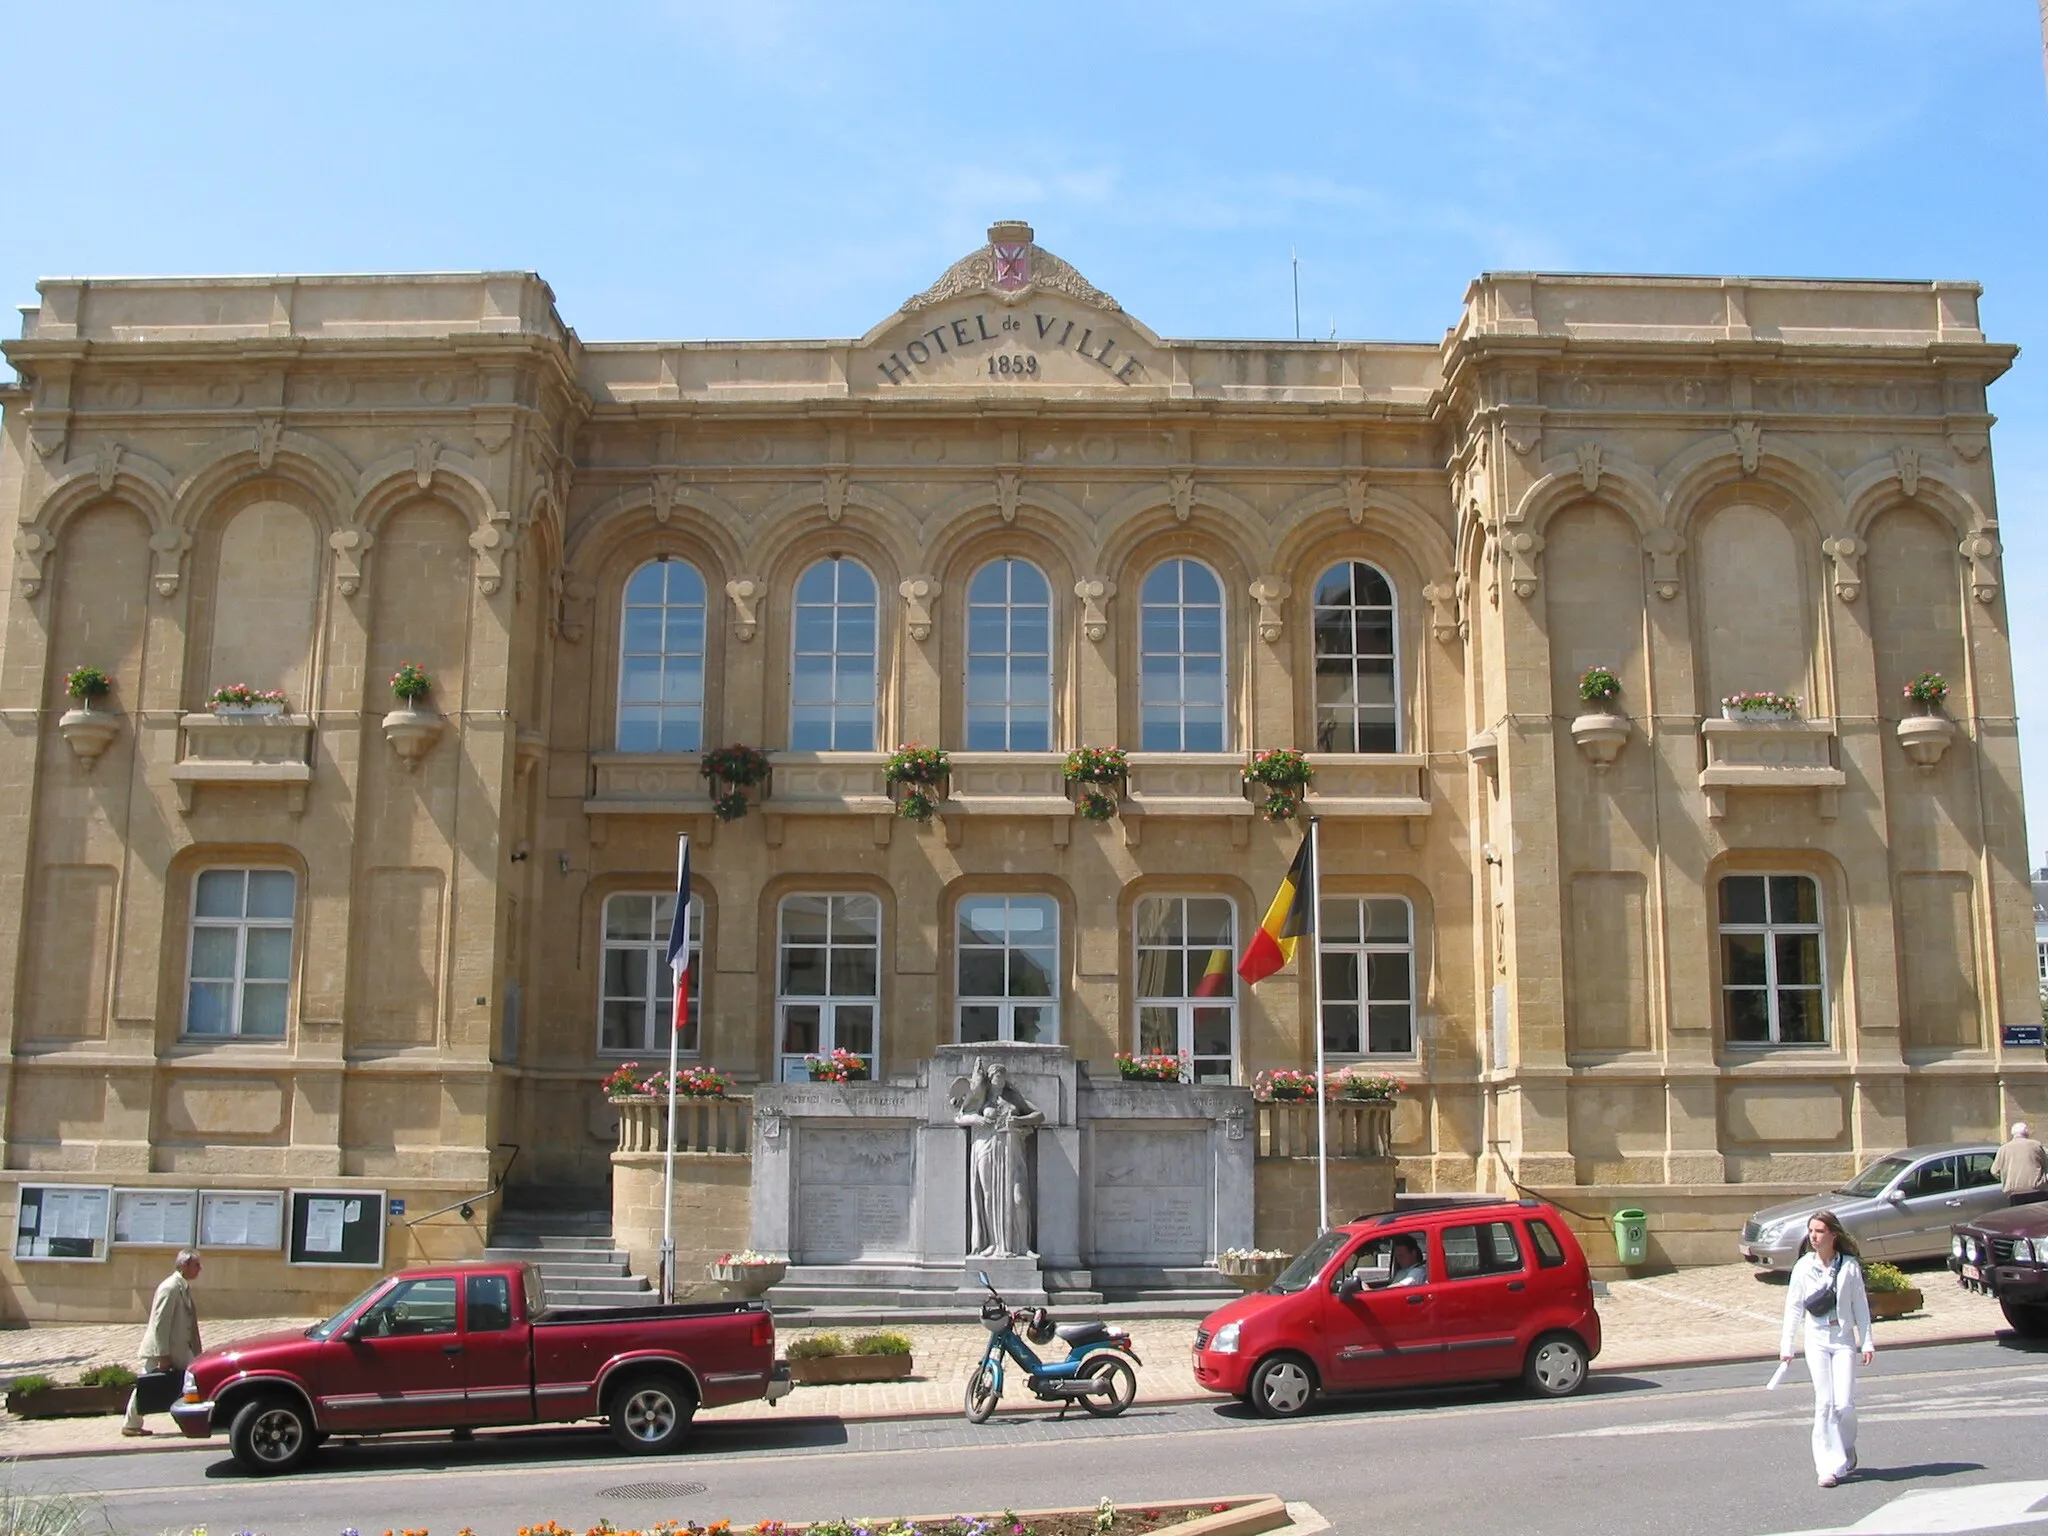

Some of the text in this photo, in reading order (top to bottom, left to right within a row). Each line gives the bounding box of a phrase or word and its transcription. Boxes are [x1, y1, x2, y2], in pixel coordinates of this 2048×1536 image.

[877, 314, 1145, 385] HOTEL de VILLE
[987, 353, 1038, 375] 1859
